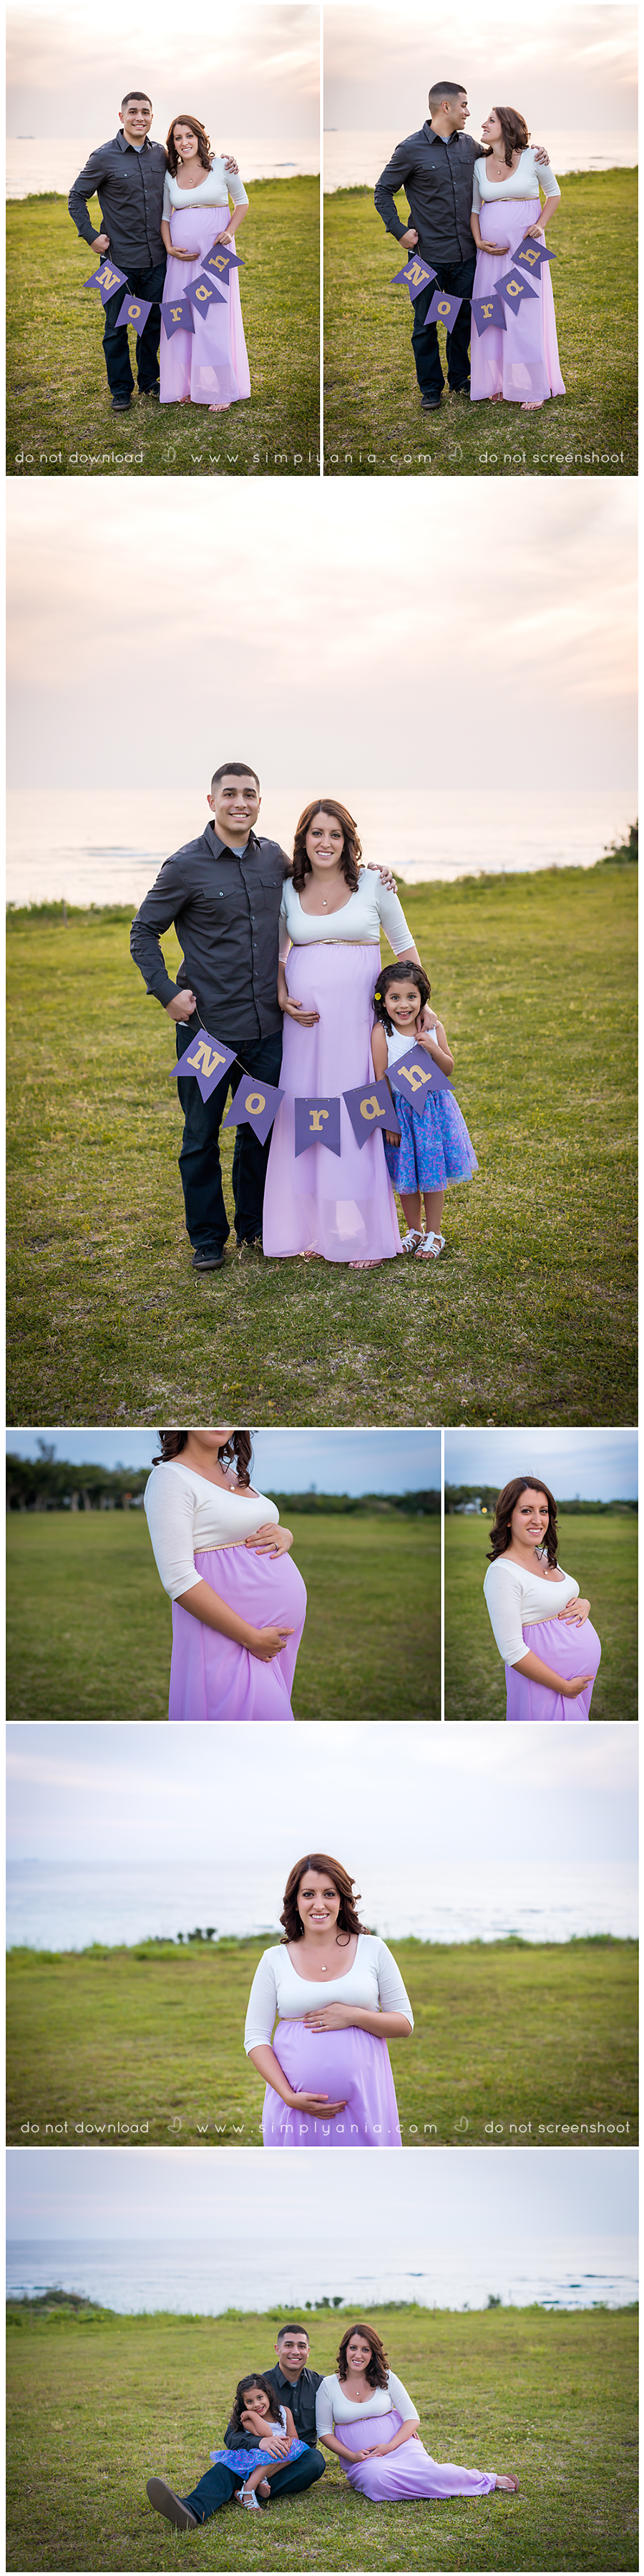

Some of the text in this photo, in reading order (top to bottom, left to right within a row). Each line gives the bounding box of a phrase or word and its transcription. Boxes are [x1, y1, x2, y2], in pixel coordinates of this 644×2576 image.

[94, 250, 230, 322] Norah
[403, 248, 541, 319] Norah
[186, 1040, 432, 1131] Norah
